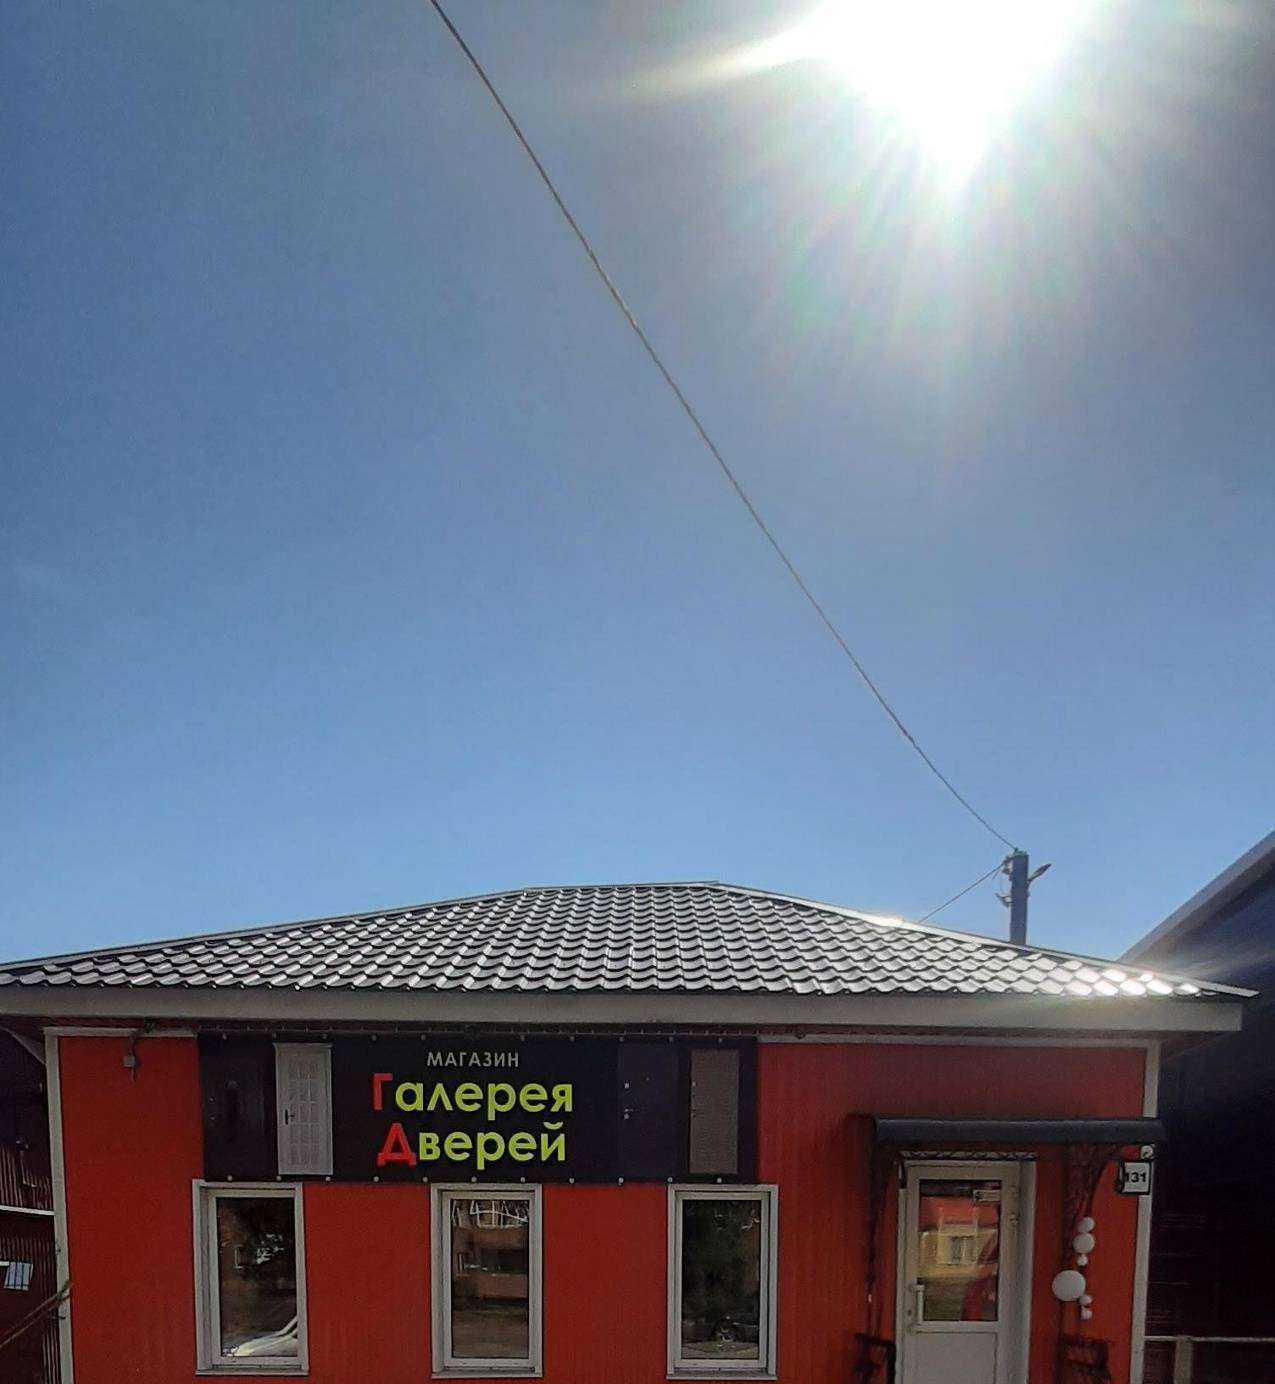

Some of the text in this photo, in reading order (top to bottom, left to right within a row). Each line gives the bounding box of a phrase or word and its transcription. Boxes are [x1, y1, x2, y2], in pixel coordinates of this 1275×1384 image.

[426, 1051, 519, 1068] МАГАЗИН
[372, 1073, 573, 1121] Галерея
[377, 1121, 567, 1171] Дверей
